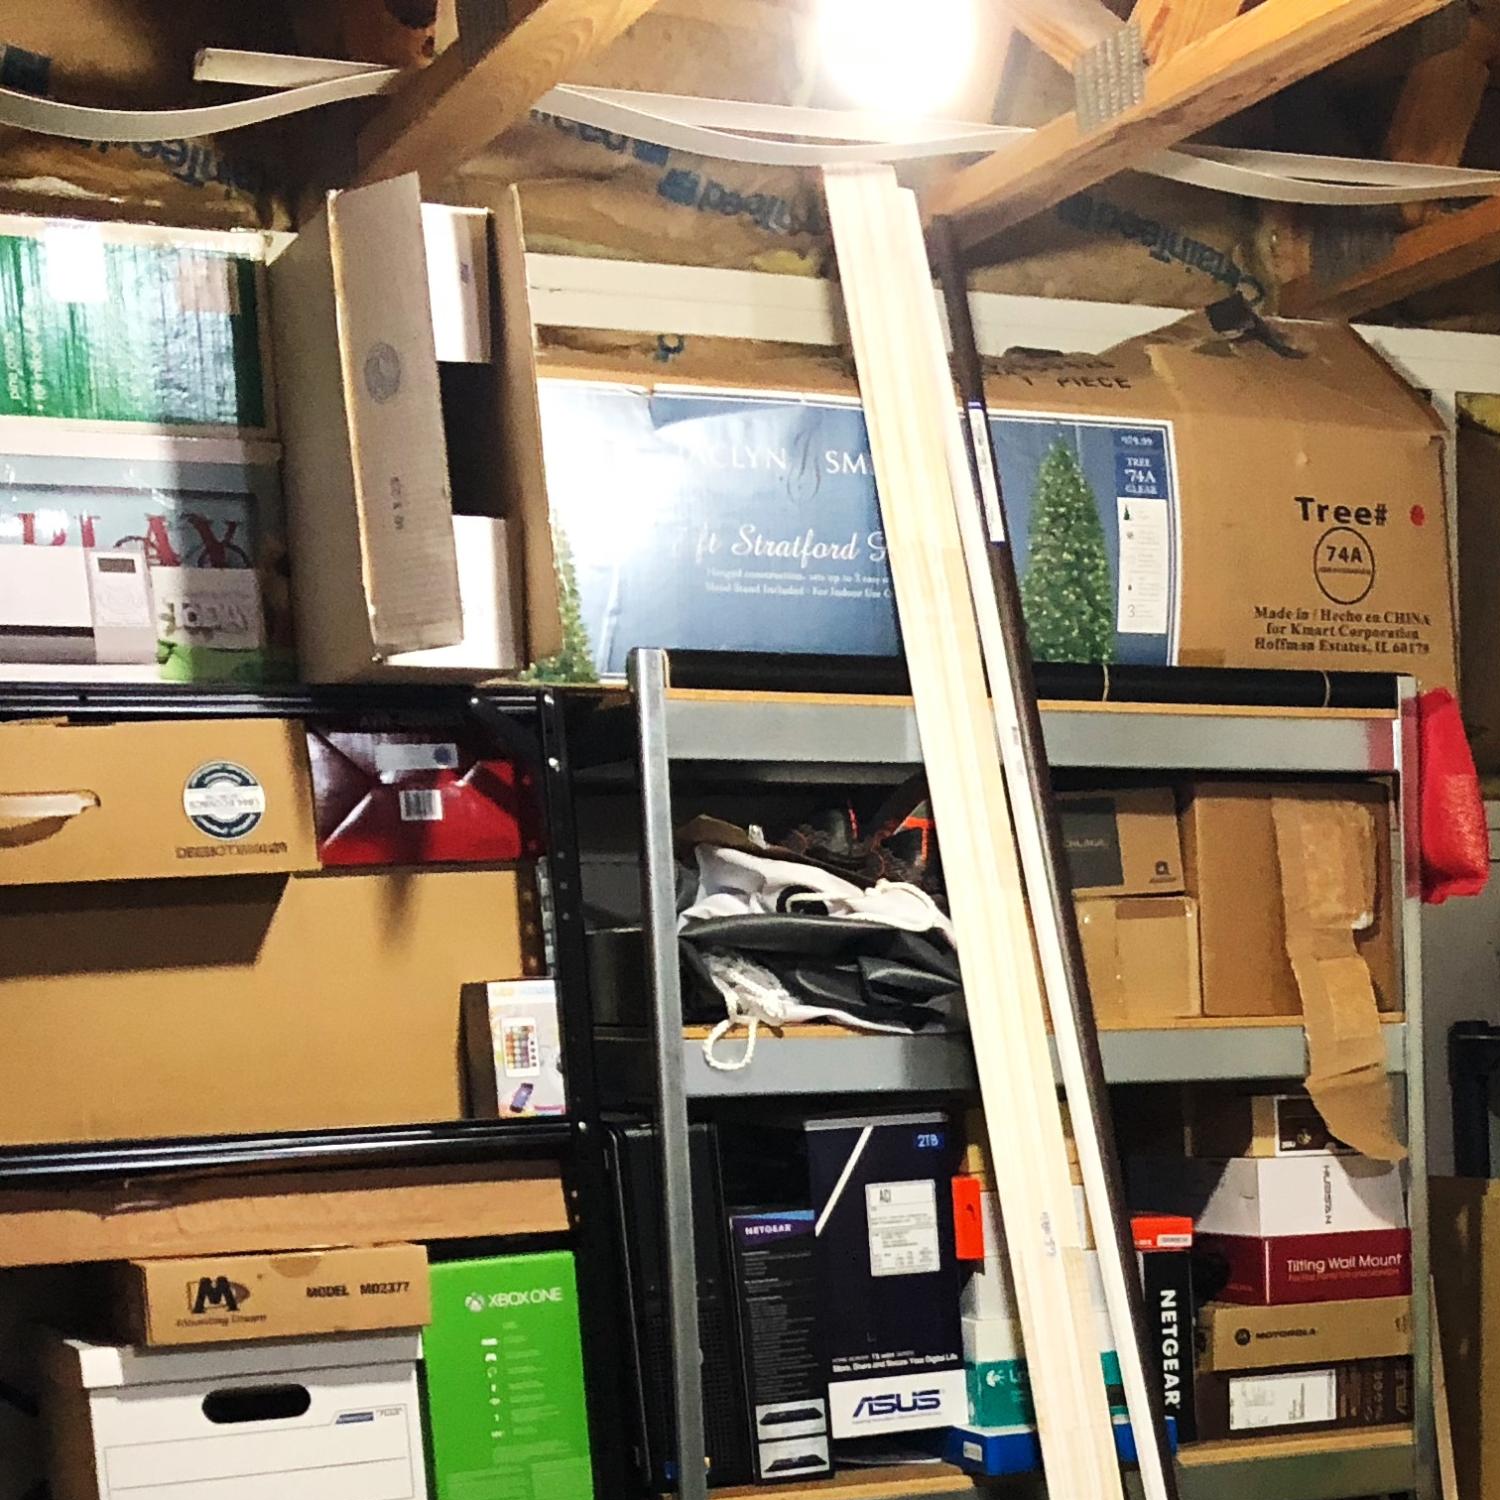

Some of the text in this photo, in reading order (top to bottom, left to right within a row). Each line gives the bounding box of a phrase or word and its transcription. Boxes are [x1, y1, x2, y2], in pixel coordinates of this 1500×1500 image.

[1294, 496, 1388, 527] Tree#
[731, 523, 860, 569] Stratford
[1326, 546, 1363, 564] 74A
[1254, 606, 1292, 620] Made
[1296, 607, 1309, 621] in
[1320, 608, 1364, 623] Hecho
[1365, 612, 1382, 623] en
[1384, 611, 1432, 626] CHINA
[1266, 622, 1420, 641] for Kmart Corporation
[1254, 637, 1315, 651] Hoffman
[917, 1134, 939, 1148] 2TB
[745, 1224, 792, 1235] NETGEAR
[1287, 1254, 1402, 1275] Tilting Wall Mount
[306, 1285, 349, 1298] MODEL
[1256, 1328, 1317, 1340] MOTOROLA
[1160, 1289, 1181, 1407] NETGEAR
[852, 1389, 941, 1418] ASUS
